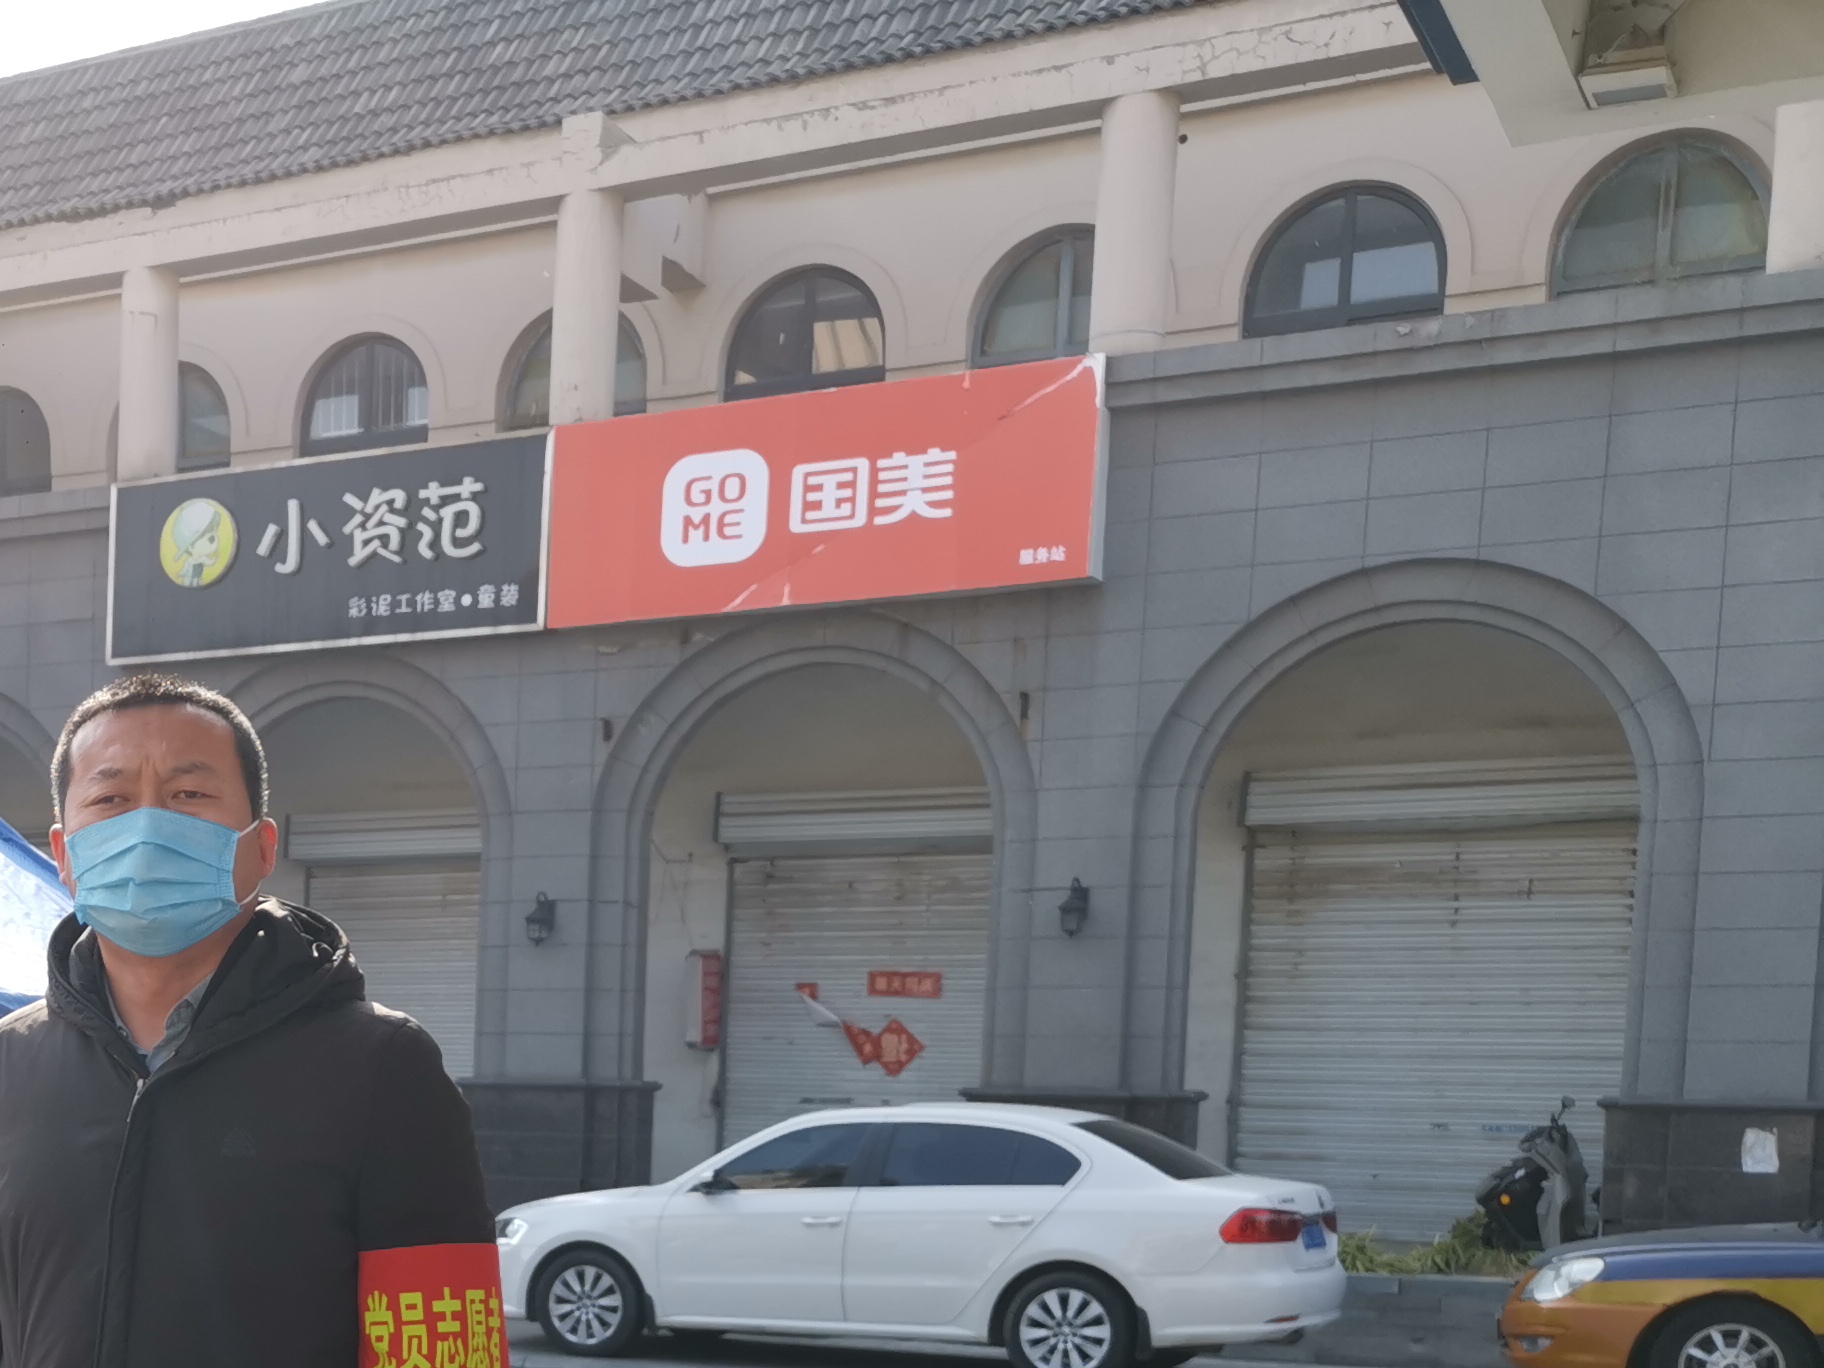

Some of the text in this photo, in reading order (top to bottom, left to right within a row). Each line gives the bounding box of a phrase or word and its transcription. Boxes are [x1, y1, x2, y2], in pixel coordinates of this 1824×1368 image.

[683, 472, 747, 508] GO
[789, 448, 957, 534] 国美
[256, 476, 486, 576] 小资范
[682, 508, 745, 545] ME
